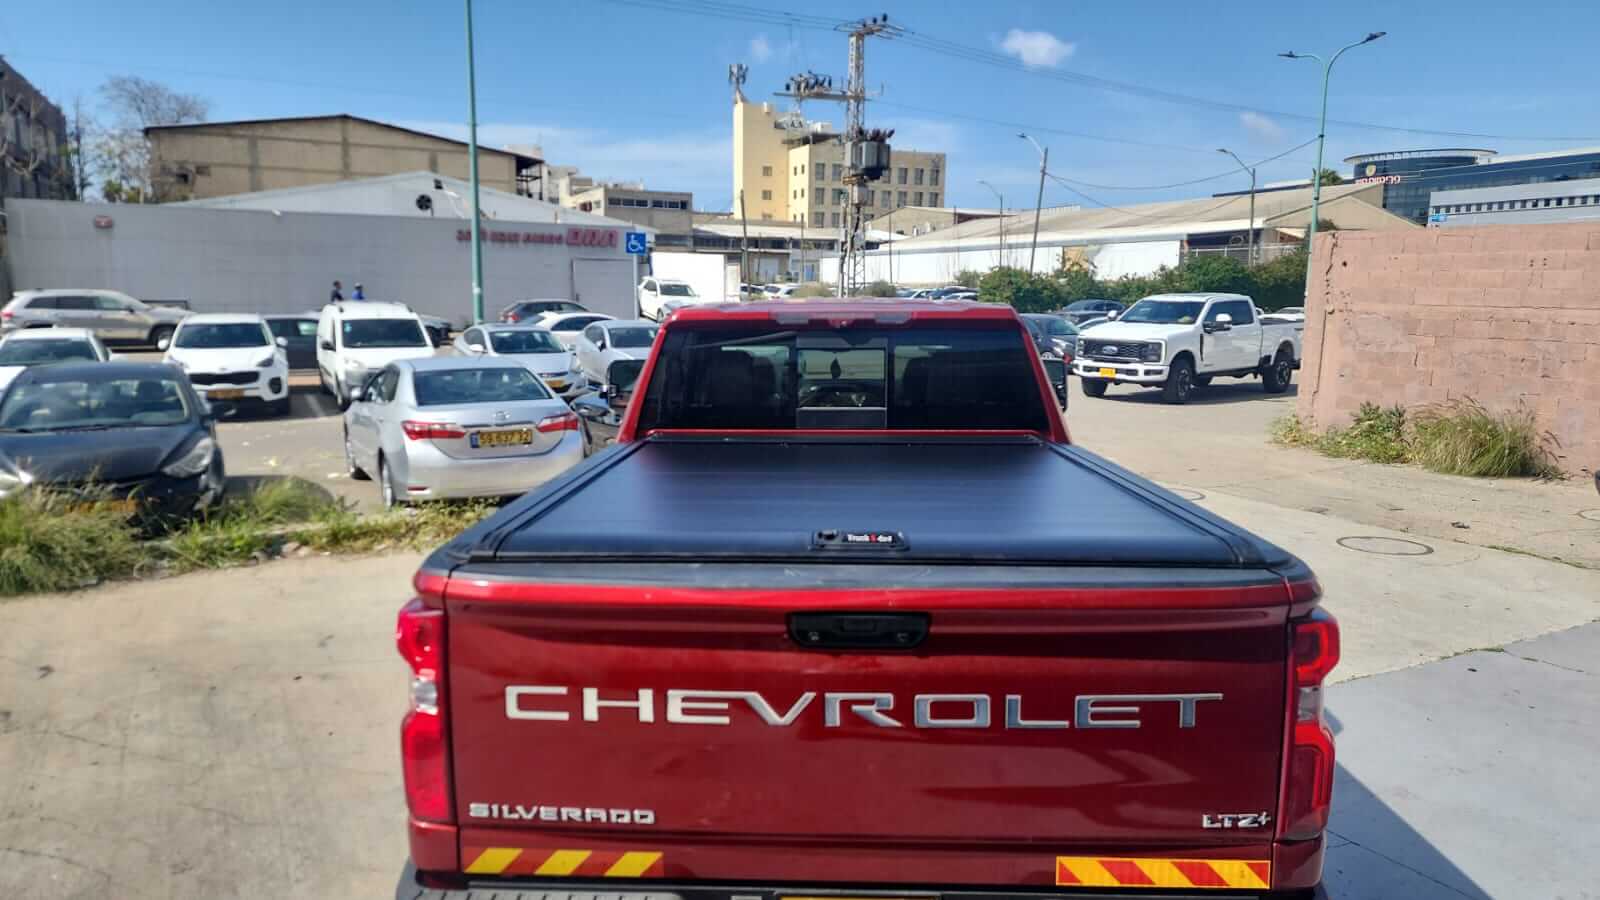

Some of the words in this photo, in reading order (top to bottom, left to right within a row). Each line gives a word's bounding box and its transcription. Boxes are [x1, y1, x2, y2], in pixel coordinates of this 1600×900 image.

[505, 685, 1224, 730] CHEVROLET
[468, 802, 656, 825] SILVERADO
[1201, 811, 1271, 829] LTZ+
